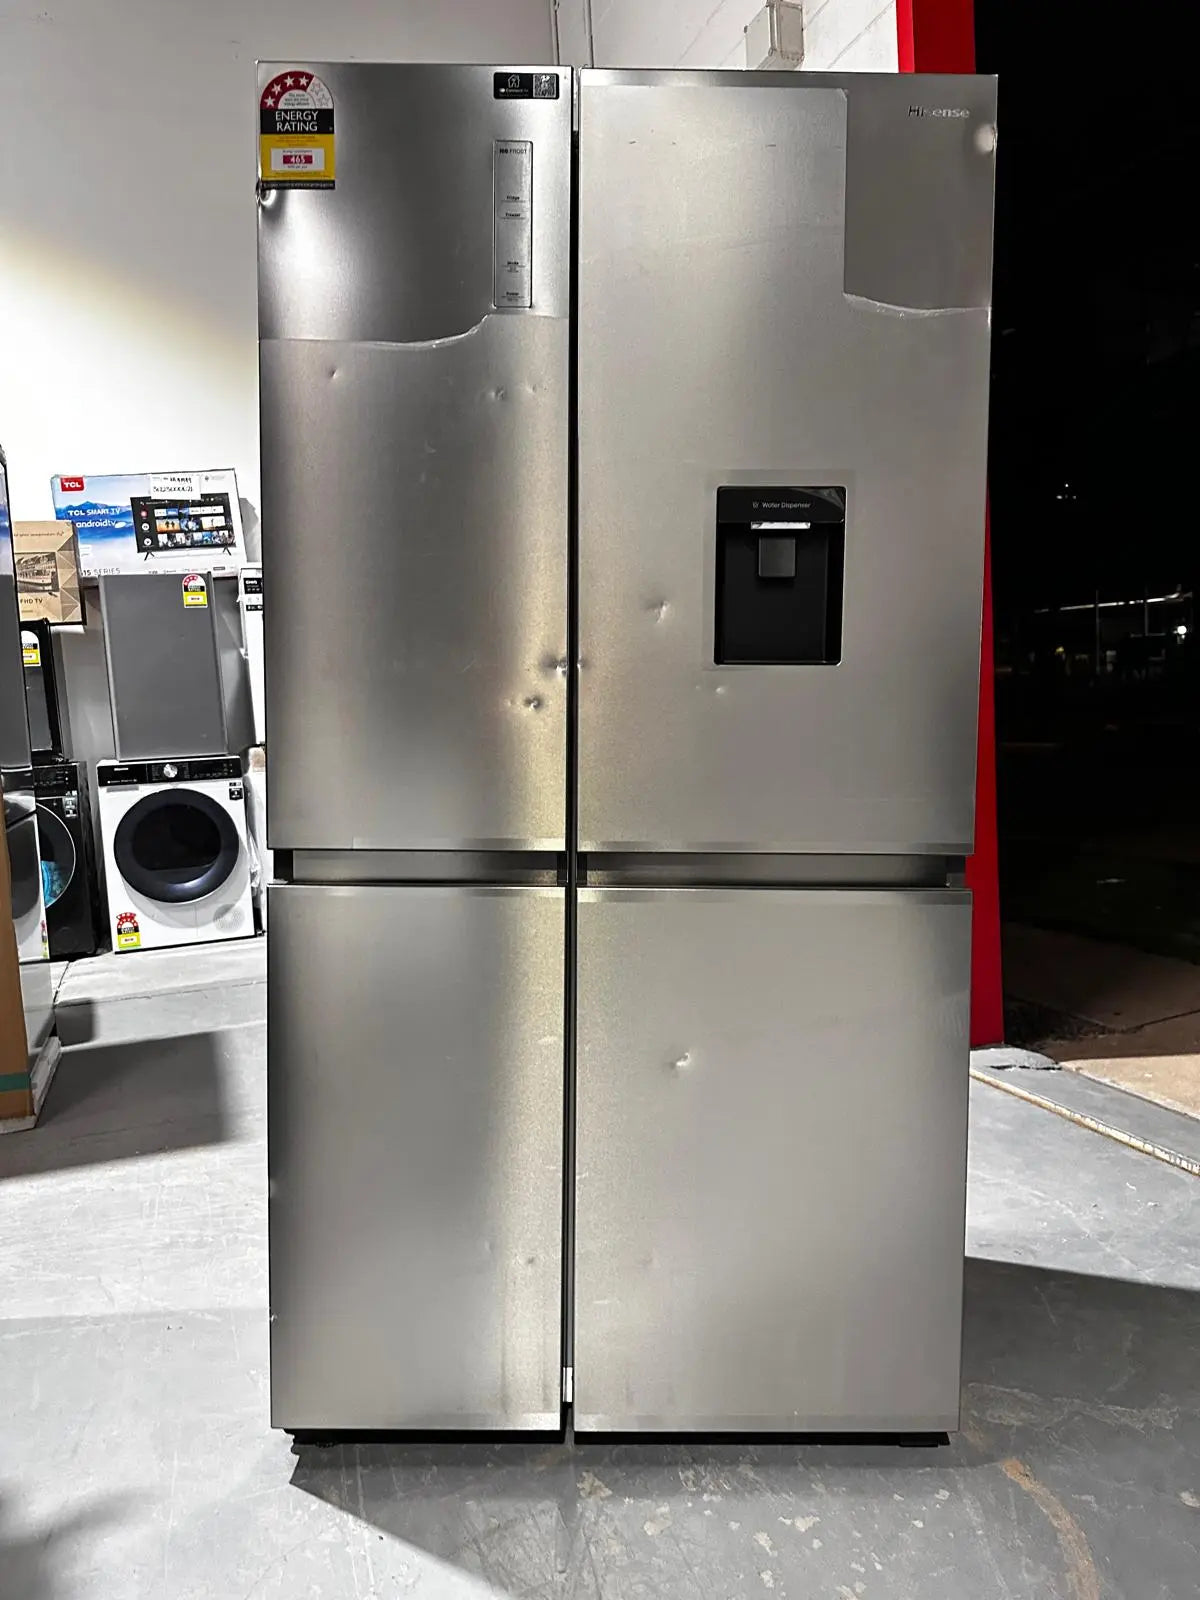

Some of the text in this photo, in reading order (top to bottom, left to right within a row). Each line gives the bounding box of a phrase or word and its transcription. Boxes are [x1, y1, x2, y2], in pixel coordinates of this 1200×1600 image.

[275, 110, 319, 121] ENERGY
[908, 105, 970, 118] Hiense
[276, 121, 318, 132] RATING
[290, 155, 306, 165] 465
[86, 508, 109, 516] SMART
[110, 507, 121, 515] TV
[93, 567, 121, 575] SERIES
